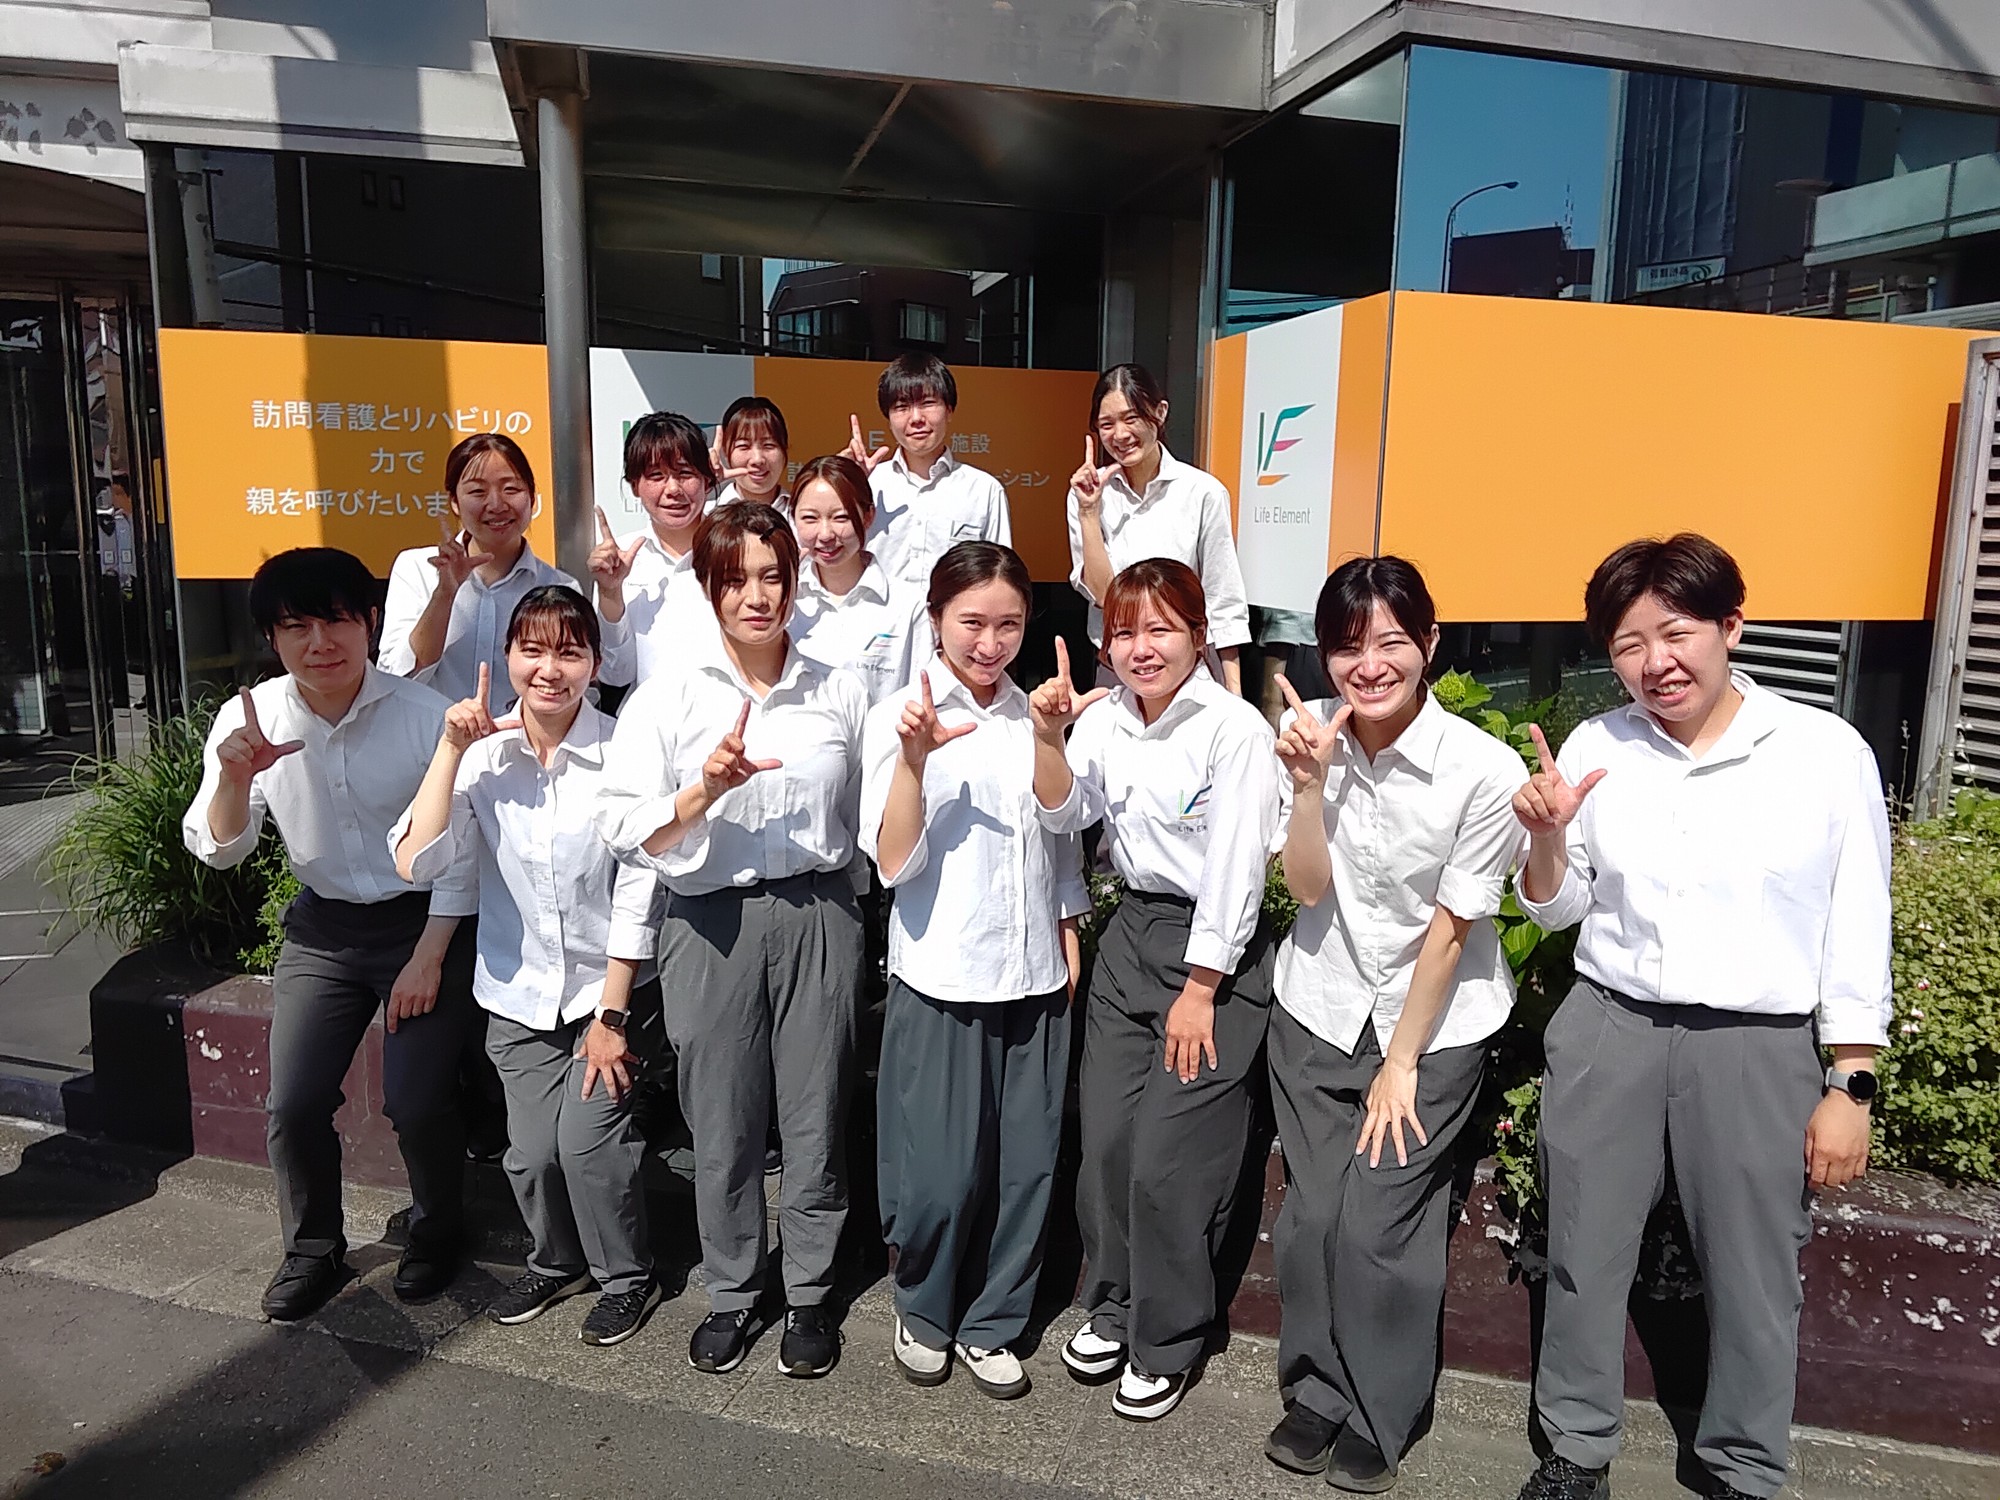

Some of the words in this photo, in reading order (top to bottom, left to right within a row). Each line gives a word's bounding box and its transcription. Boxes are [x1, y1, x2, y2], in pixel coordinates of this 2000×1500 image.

[251, 399, 532, 435] 訪問看護とリハビリの
[951, 433, 991, 454] 施設
[369, 447, 425, 474] 力で
[246, 486, 543, 519] 親を呼びたいまり
[1254, 506, 1270, 524] Life
[1273, 506, 1311, 525] Element
